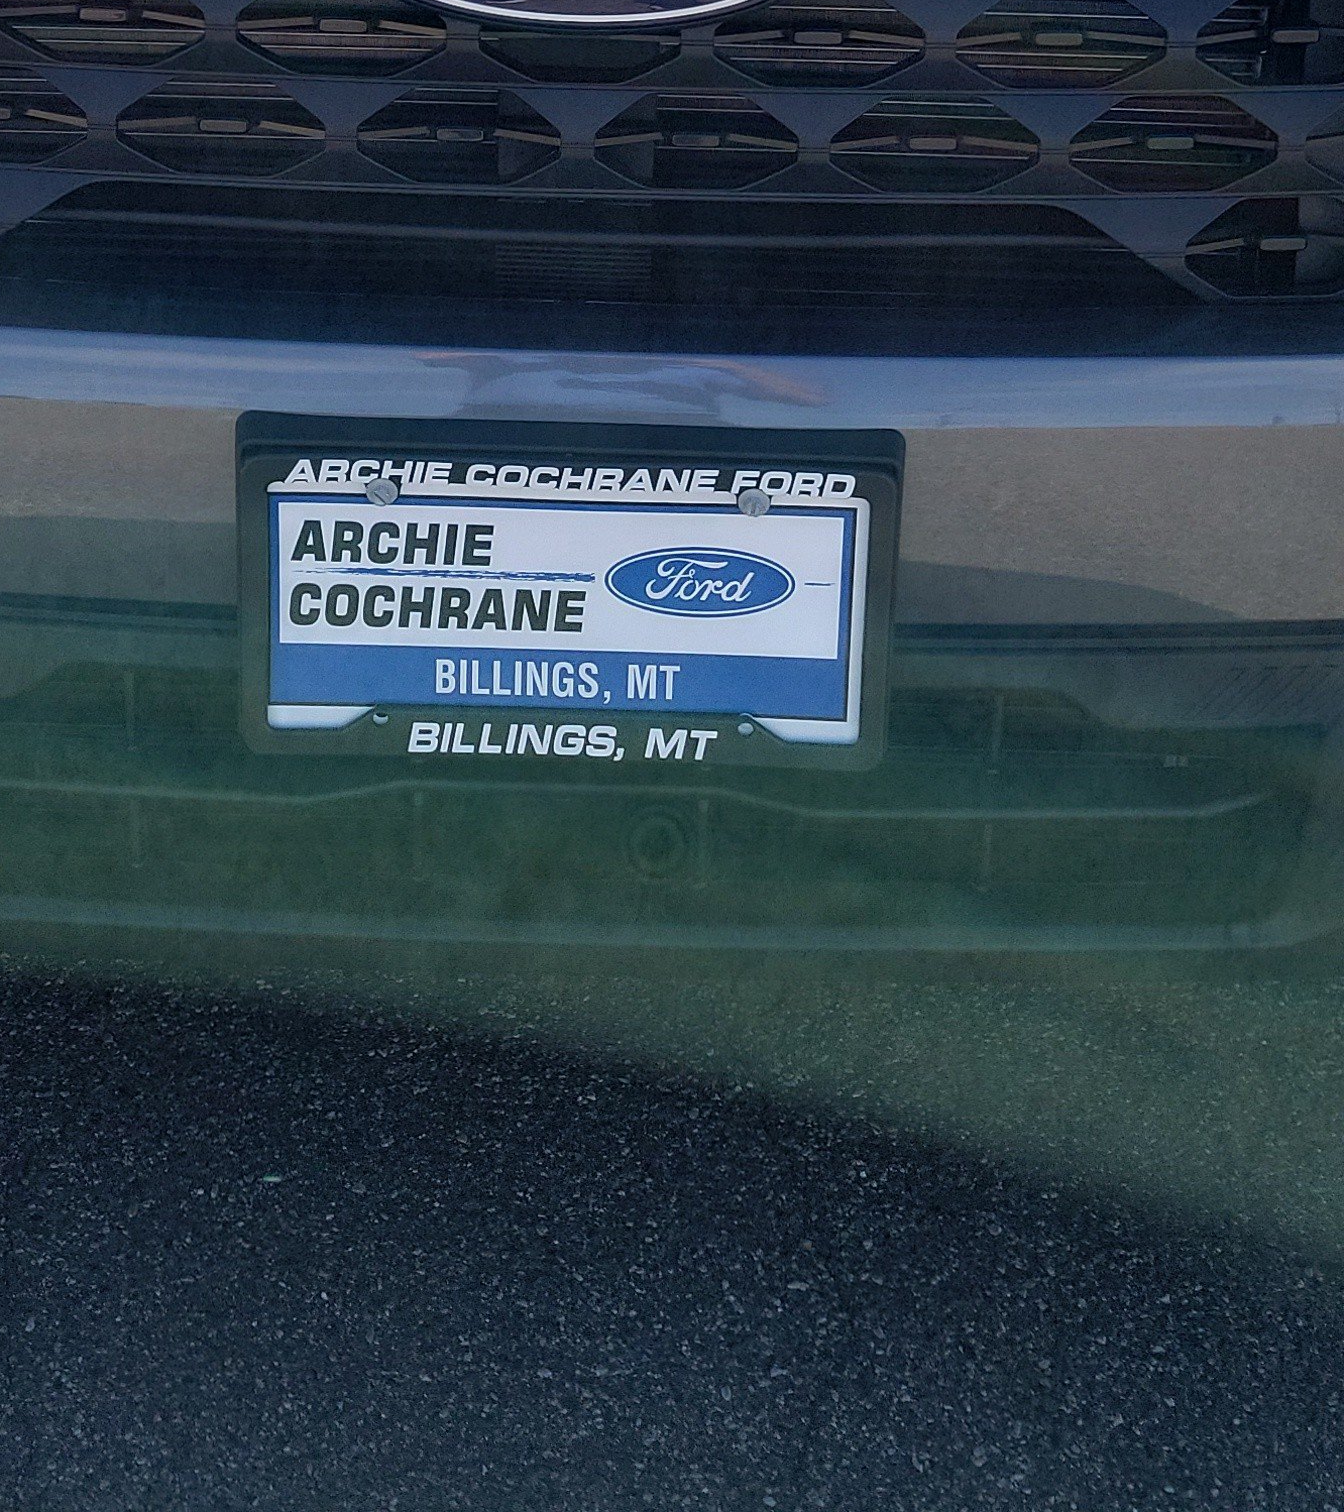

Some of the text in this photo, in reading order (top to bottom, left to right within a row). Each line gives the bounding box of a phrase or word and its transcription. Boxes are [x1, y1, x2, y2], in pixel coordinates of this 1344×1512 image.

[284, 459, 856, 499] ARCHIE COCHRANE FORD
[290, 519, 495, 567] ARCHIE
[645, 557, 755, 603] Ford
[288, 582, 587, 633] COCHRANE
[435, 658, 681, 704] BILLINGS, MT
[407, 722, 718, 761] BILLINGS, MT
